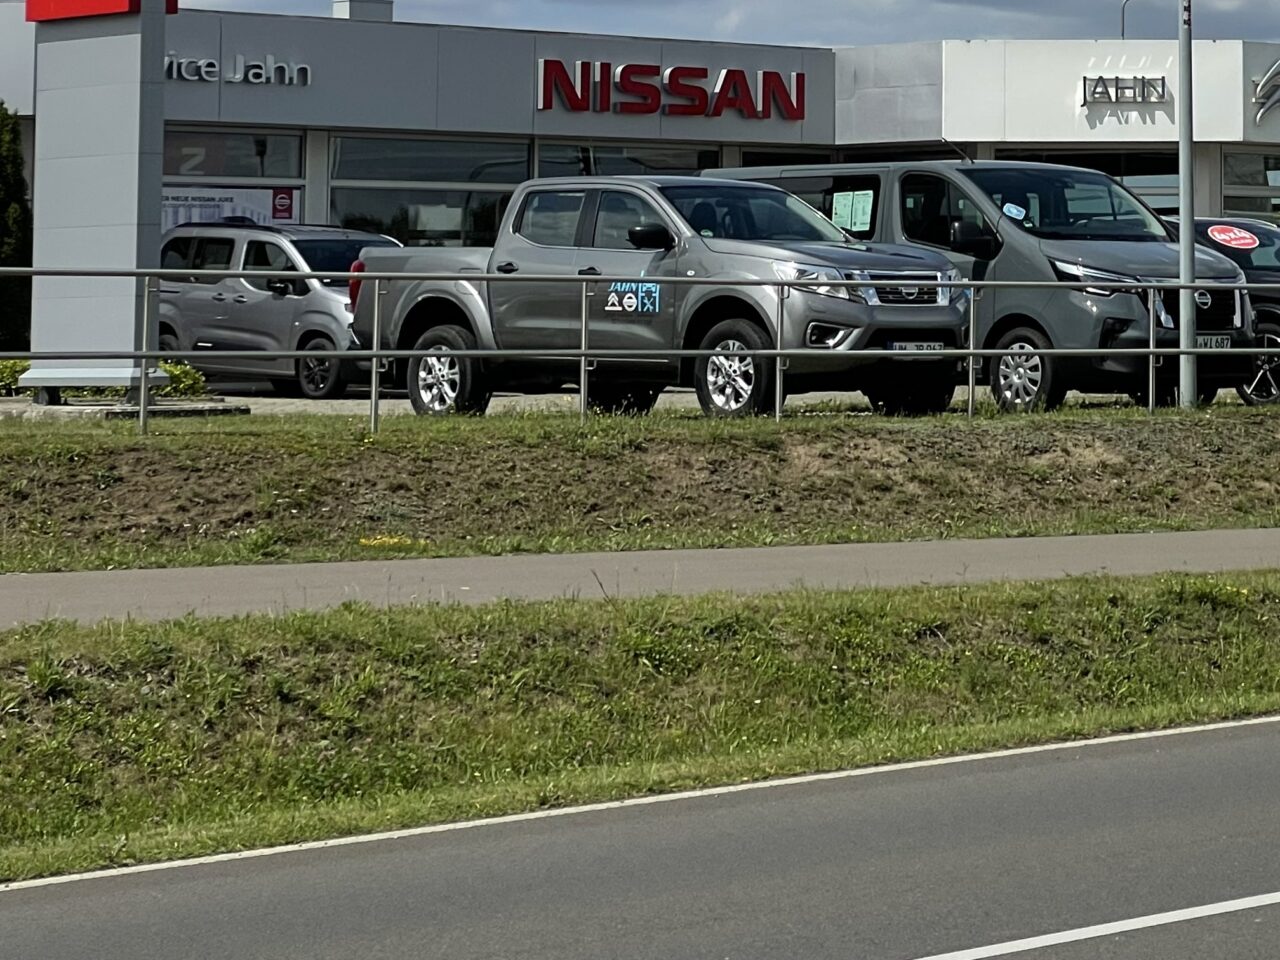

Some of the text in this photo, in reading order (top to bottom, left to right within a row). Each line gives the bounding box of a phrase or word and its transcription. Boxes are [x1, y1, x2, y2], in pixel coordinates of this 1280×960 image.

[225, 54, 311, 86] Jahn
[536, 58, 806, 121] NISSAN
[1080, 75, 1166, 108] JAHN
[608, 282, 638, 292] JAHN
